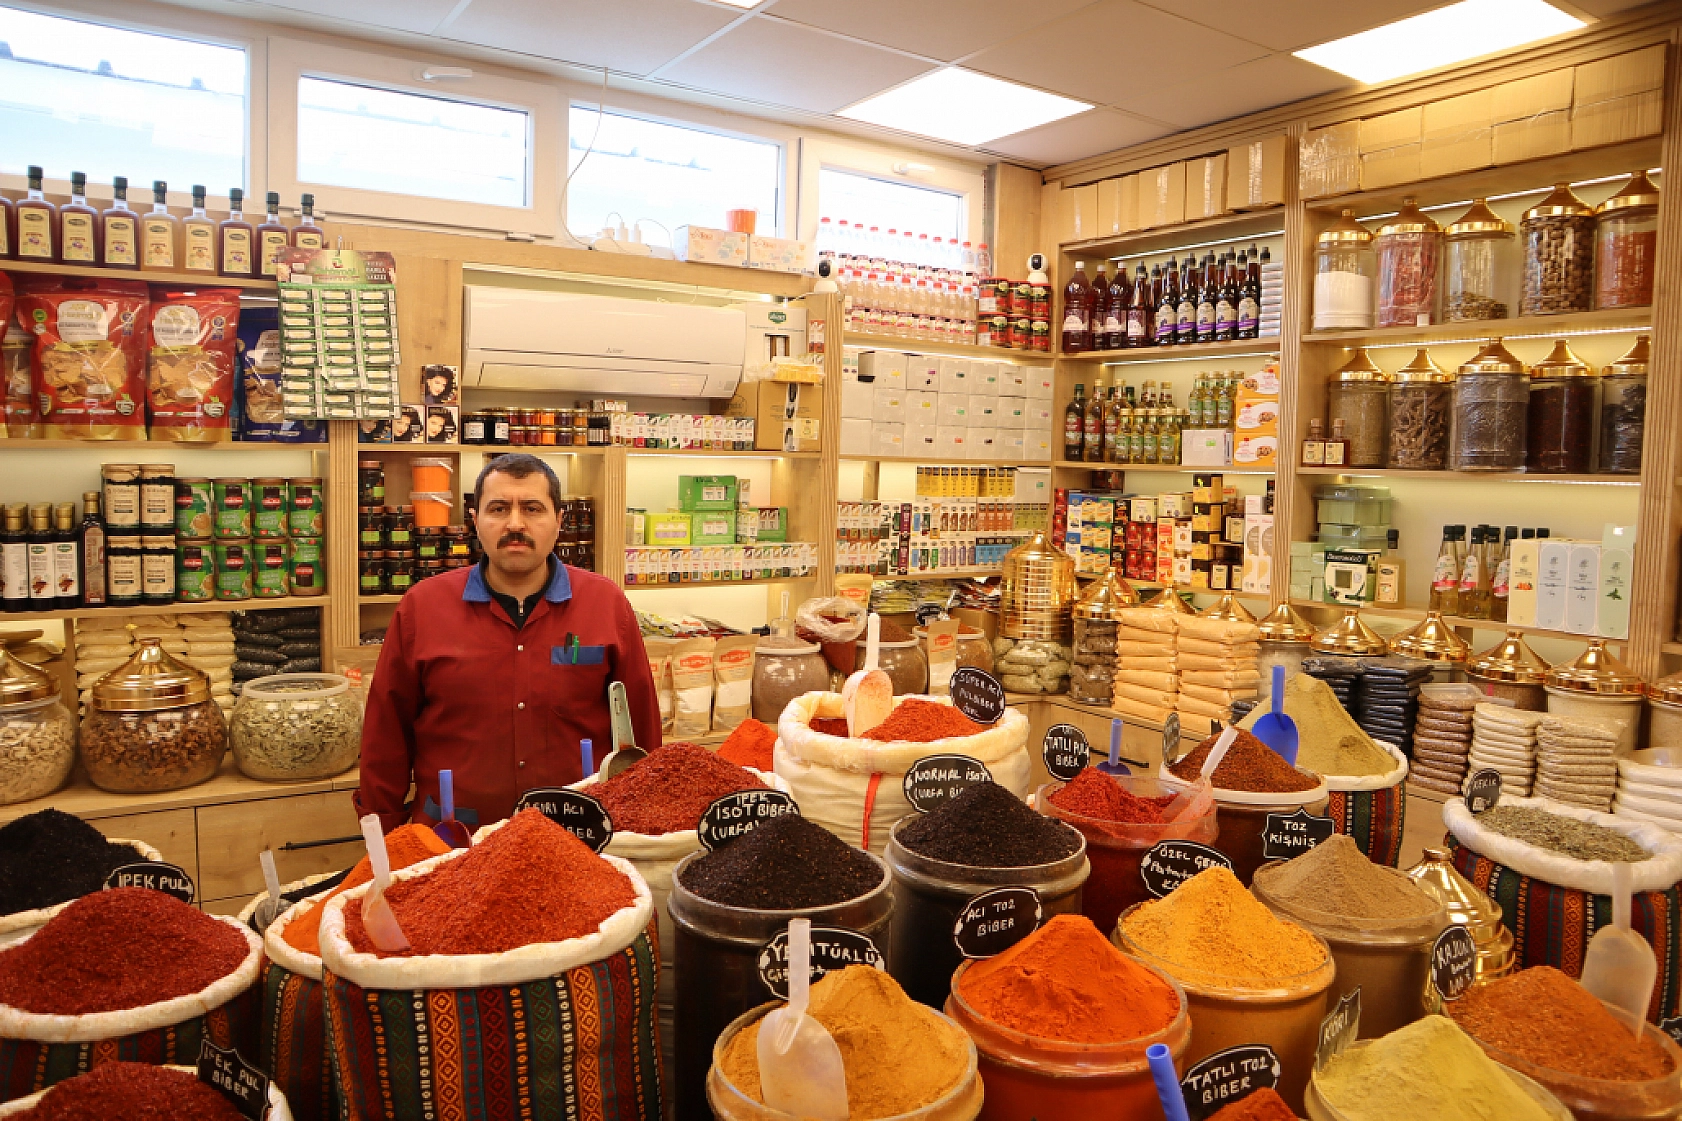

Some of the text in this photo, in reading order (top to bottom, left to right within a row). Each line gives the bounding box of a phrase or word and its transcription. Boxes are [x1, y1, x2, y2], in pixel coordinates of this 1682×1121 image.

[915, 767, 961, 783] NORMAL
[1282, 820, 1307, 832] TOZ
[977, 917, 1015, 937] BİBER
[1187, 1061, 1235, 1091] TATLI
